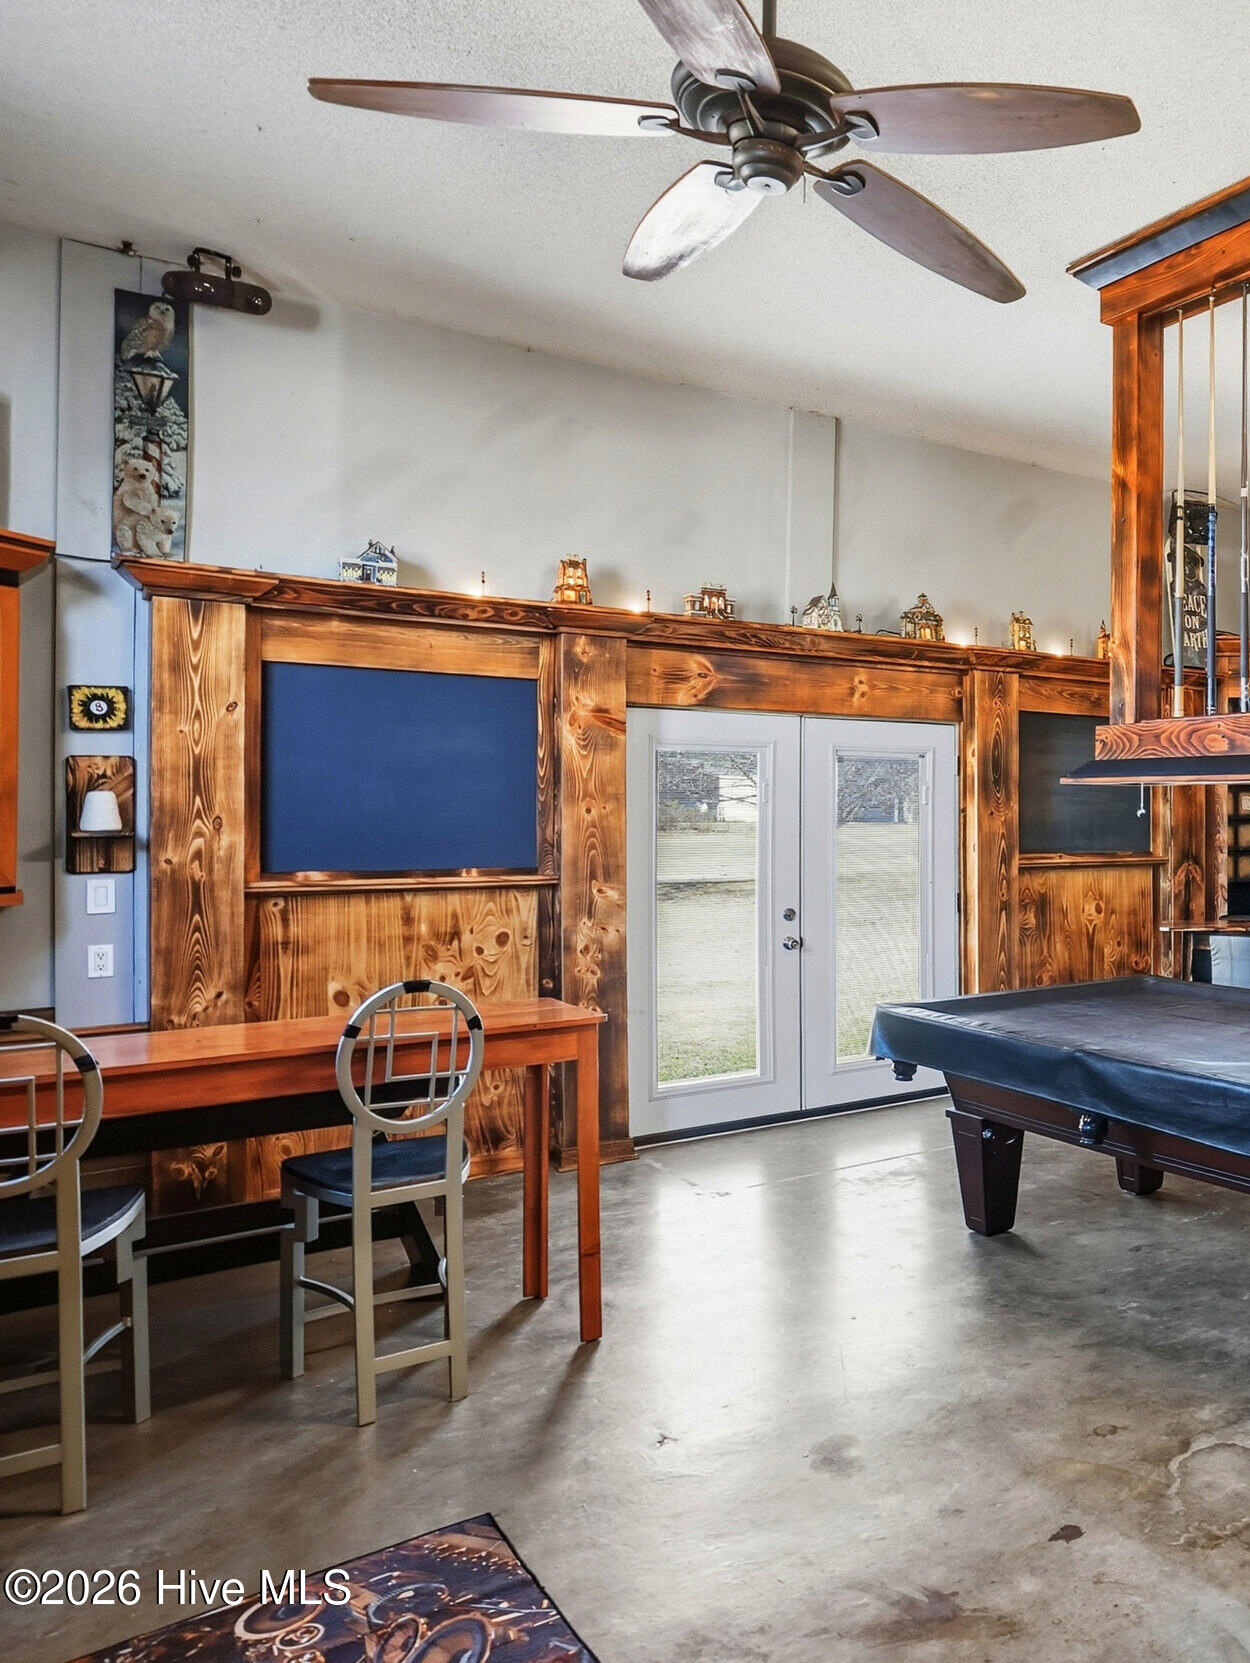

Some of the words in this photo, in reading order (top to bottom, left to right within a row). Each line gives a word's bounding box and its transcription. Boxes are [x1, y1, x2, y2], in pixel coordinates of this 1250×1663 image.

[1182, 593, 1207, 618] EACE
[1184, 615, 1199, 629] ON
[1183, 628, 1208, 651] ARTH
[95, 702, 104, 712] 8
